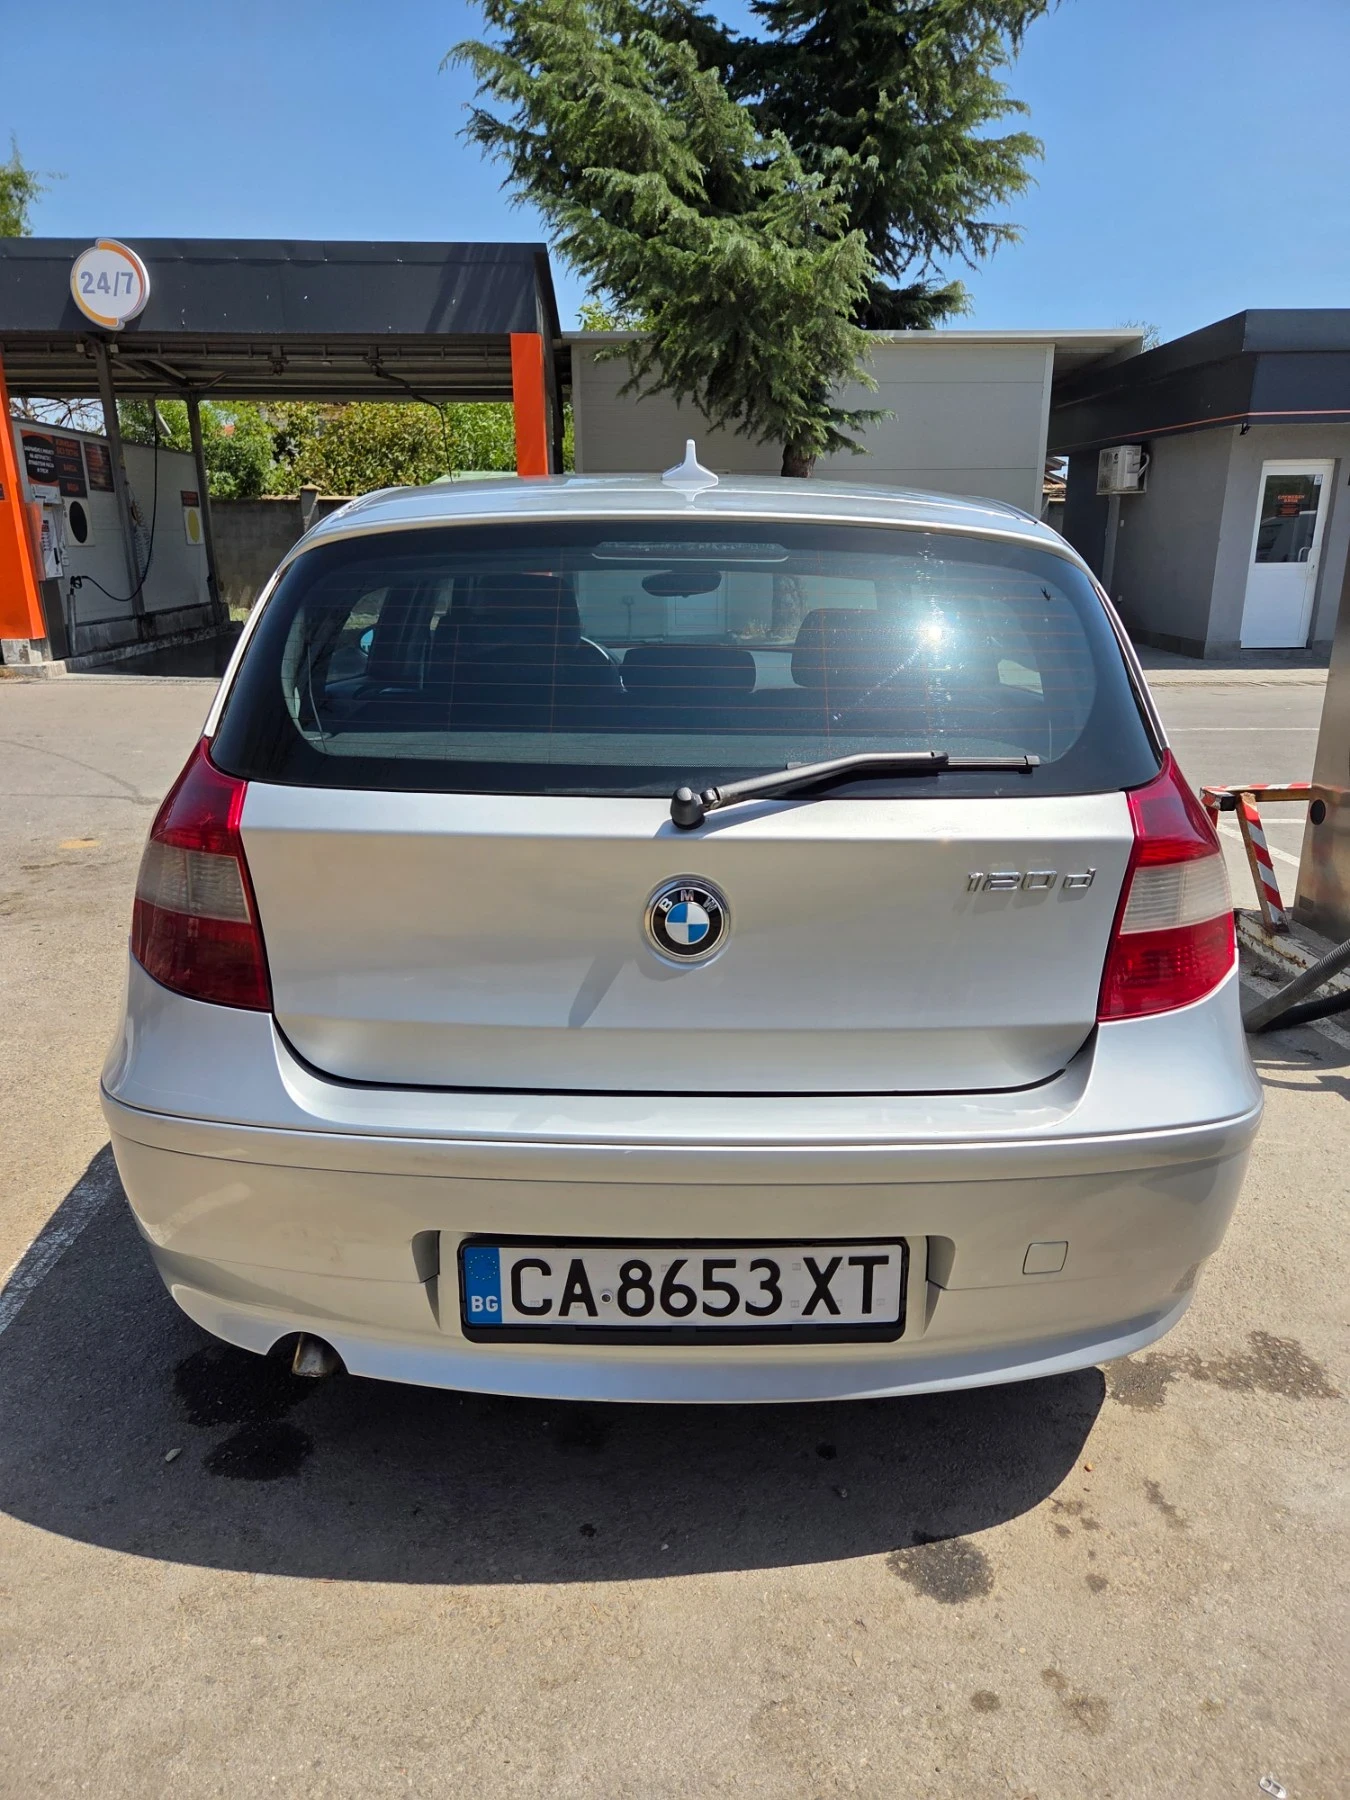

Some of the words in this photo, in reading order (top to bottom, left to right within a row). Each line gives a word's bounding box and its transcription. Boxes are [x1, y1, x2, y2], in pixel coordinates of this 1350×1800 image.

[80, 271, 134, 297] 24/7
[658, 889, 718, 913] BMW
[510, 1258, 599, 1317] CA
[617, 1258, 783, 1318] 8653
[801, 1255, 890, 1316] XT
[471, 1295, 498, 1312] BG
